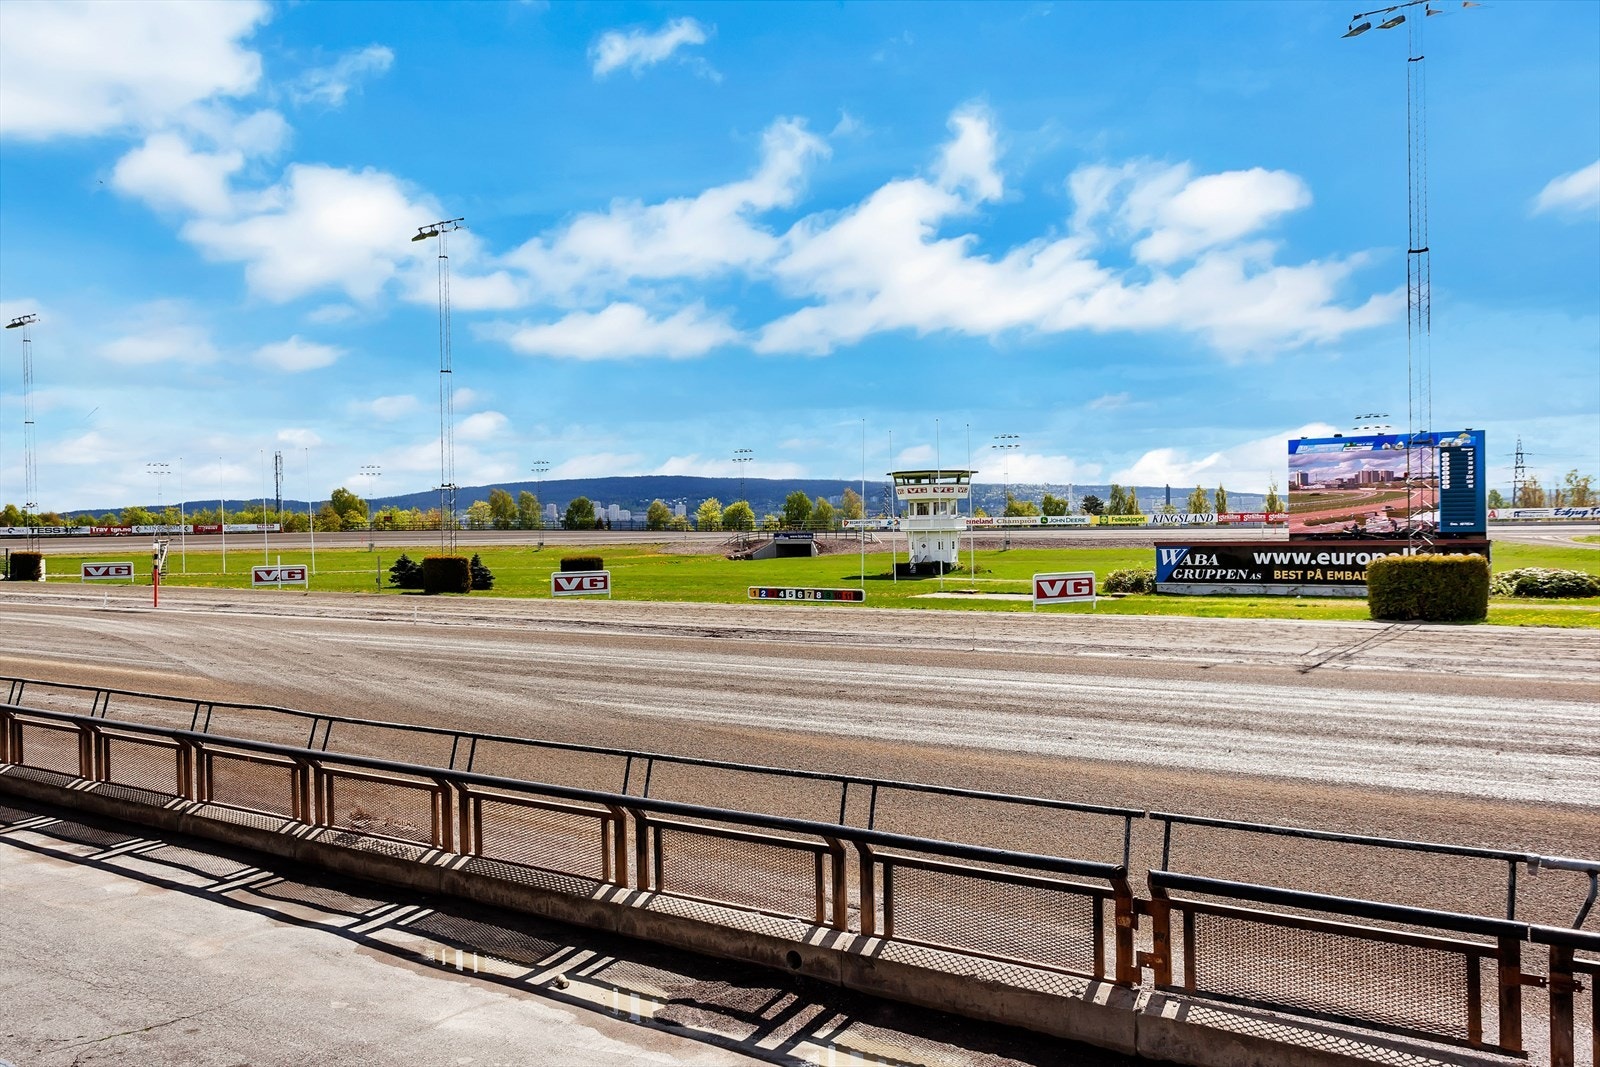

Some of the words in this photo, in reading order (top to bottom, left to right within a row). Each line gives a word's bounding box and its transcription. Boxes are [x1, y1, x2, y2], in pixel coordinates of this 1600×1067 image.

[1152, 513, 1214, 523] KINGSLAND
[1159, 548, 1220, 566] WABA
[86, 566, 129, 576] VG
[256, 569, 302, 581] VG
[1172, 569, 1249, 580] GRUPPEN
[1249, 572, 1262, 580] AS
[1273, 570, 1304, 580] BEST
[1307, 568, 1323, 580] PÅ
[556, 577, 605, 590] VG
[1038, 579, 1090, 597] VG
[779, 590, 784, 598] 4
[788, 590, 794, 598] 5
[816, 591, 822, 599] 8
